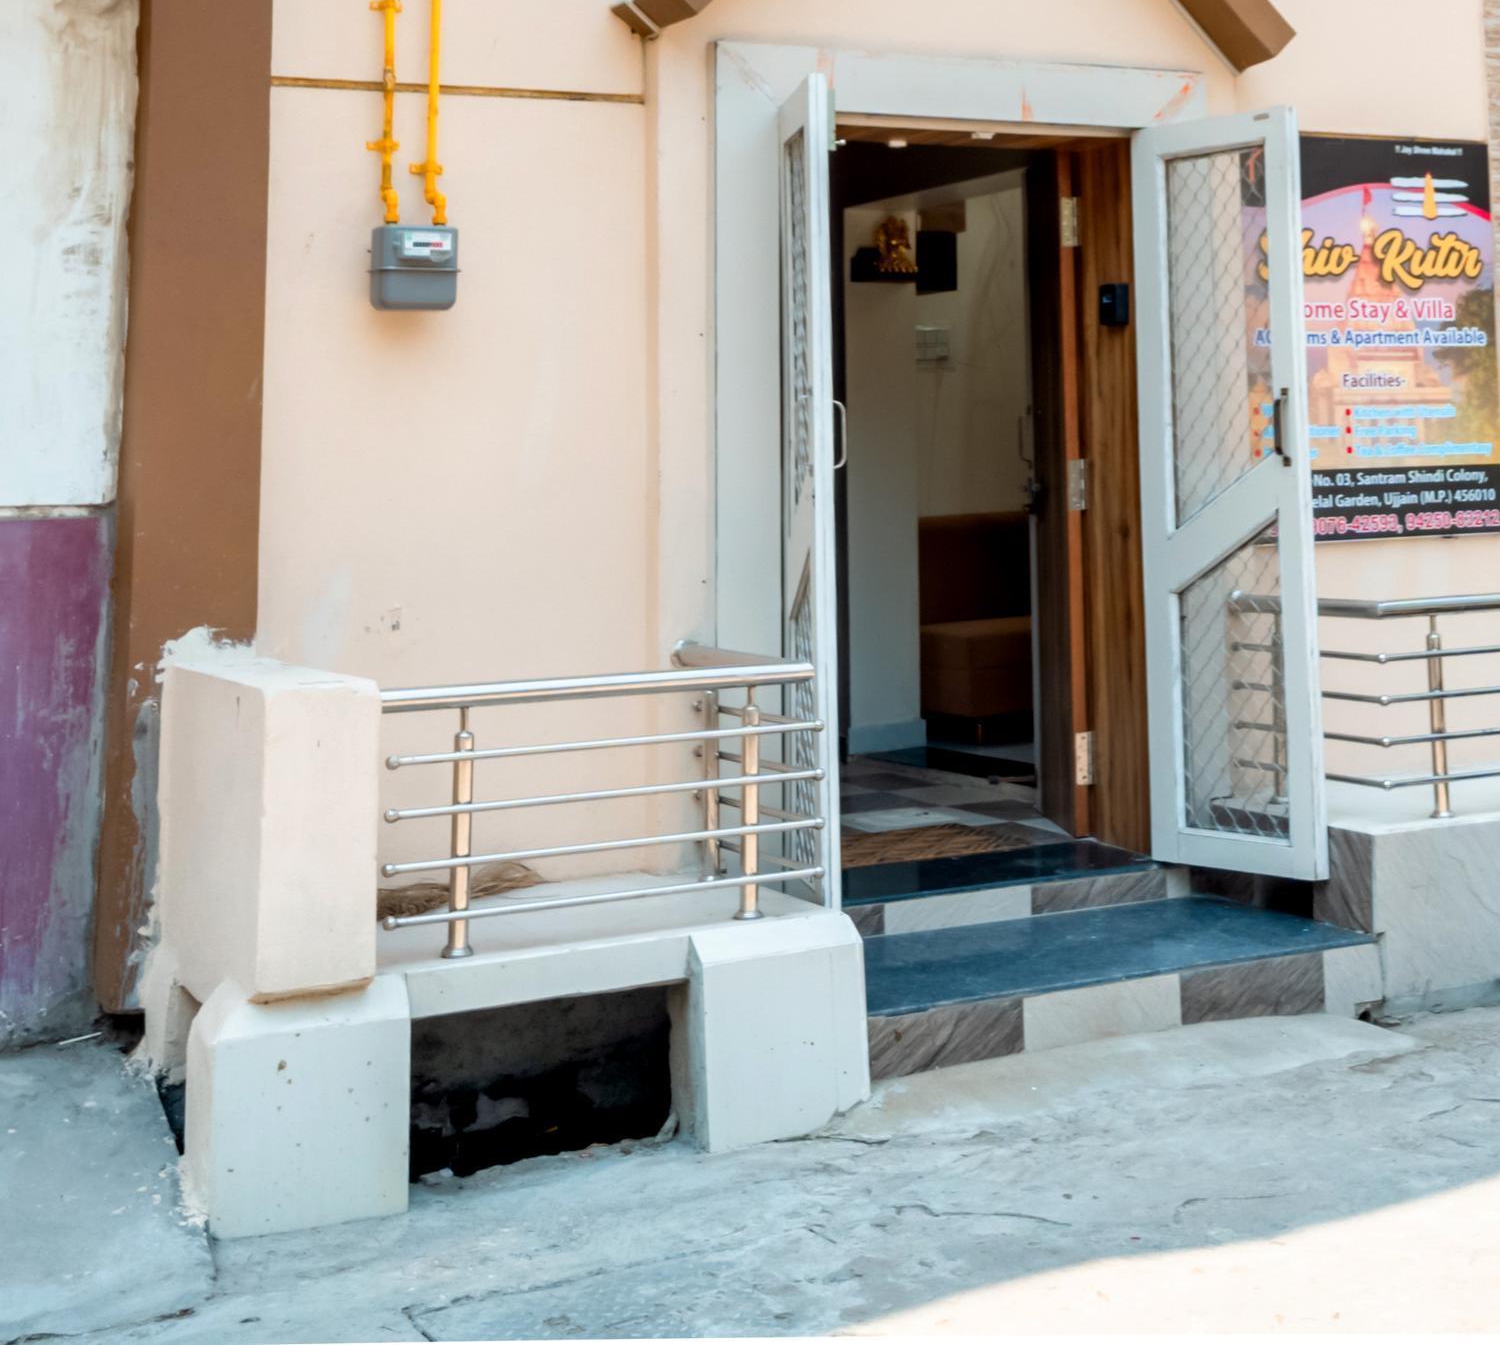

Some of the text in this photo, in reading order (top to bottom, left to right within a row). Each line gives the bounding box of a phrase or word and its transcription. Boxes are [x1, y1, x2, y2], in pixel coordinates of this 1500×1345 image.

[1257, 227, 1484, 289] hiv Kutir
[1304, 299, 1453, 323] ome Stay & Villa
[1331, 330, 1340, 344] &
[1345, 330, 1419, 347] Apartment
[1423, 329, 1485, 344] Available
[1336, 473, 1355, 487] 03,
[1356, 472, 1406, 486] Santram
[1408, 470, 1445, 484] Shindi
[1446, 469, 1488, 484] Colony,
[1312, 488, 1496, 509] elal Garden, Ujjain (M.P.) 456010
